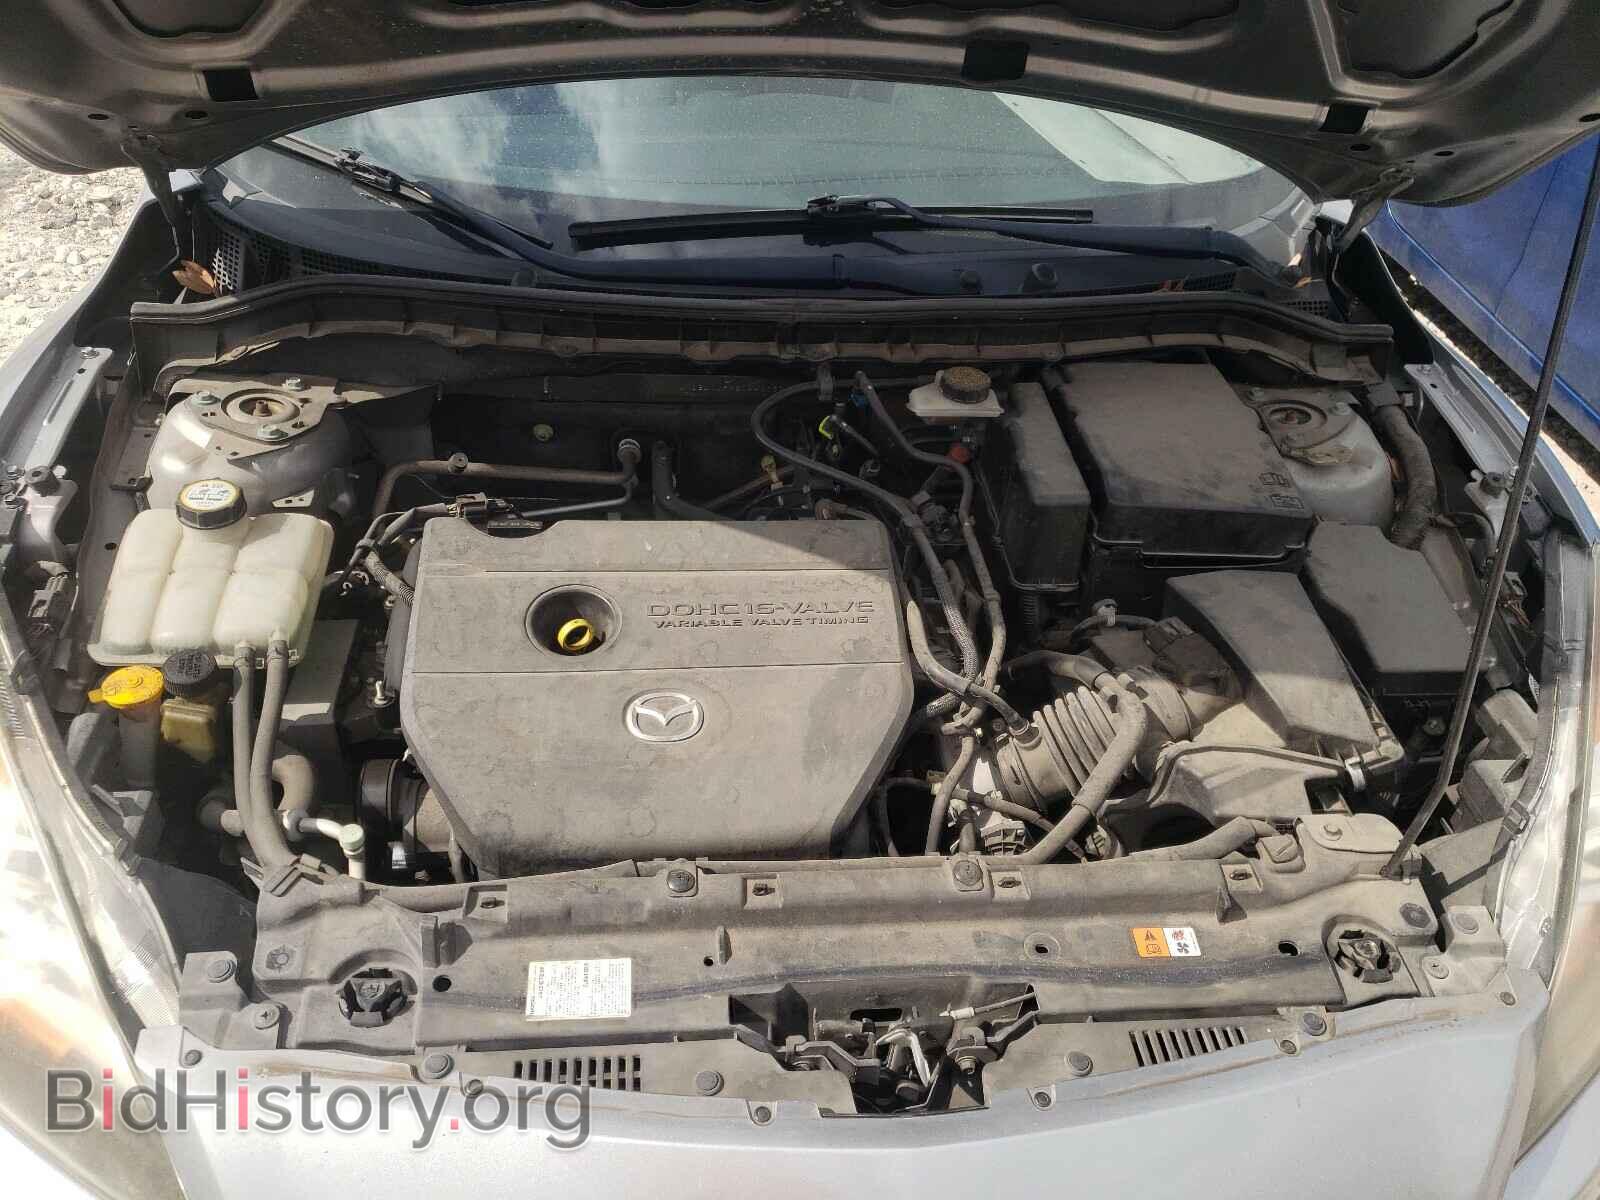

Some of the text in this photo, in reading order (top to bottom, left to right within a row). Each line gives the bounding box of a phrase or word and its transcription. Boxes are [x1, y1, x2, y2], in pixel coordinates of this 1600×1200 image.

[647, 602, 740, 617] DOHC
[656, 616, 870, 629] VARIABLE VALVE TIMING
